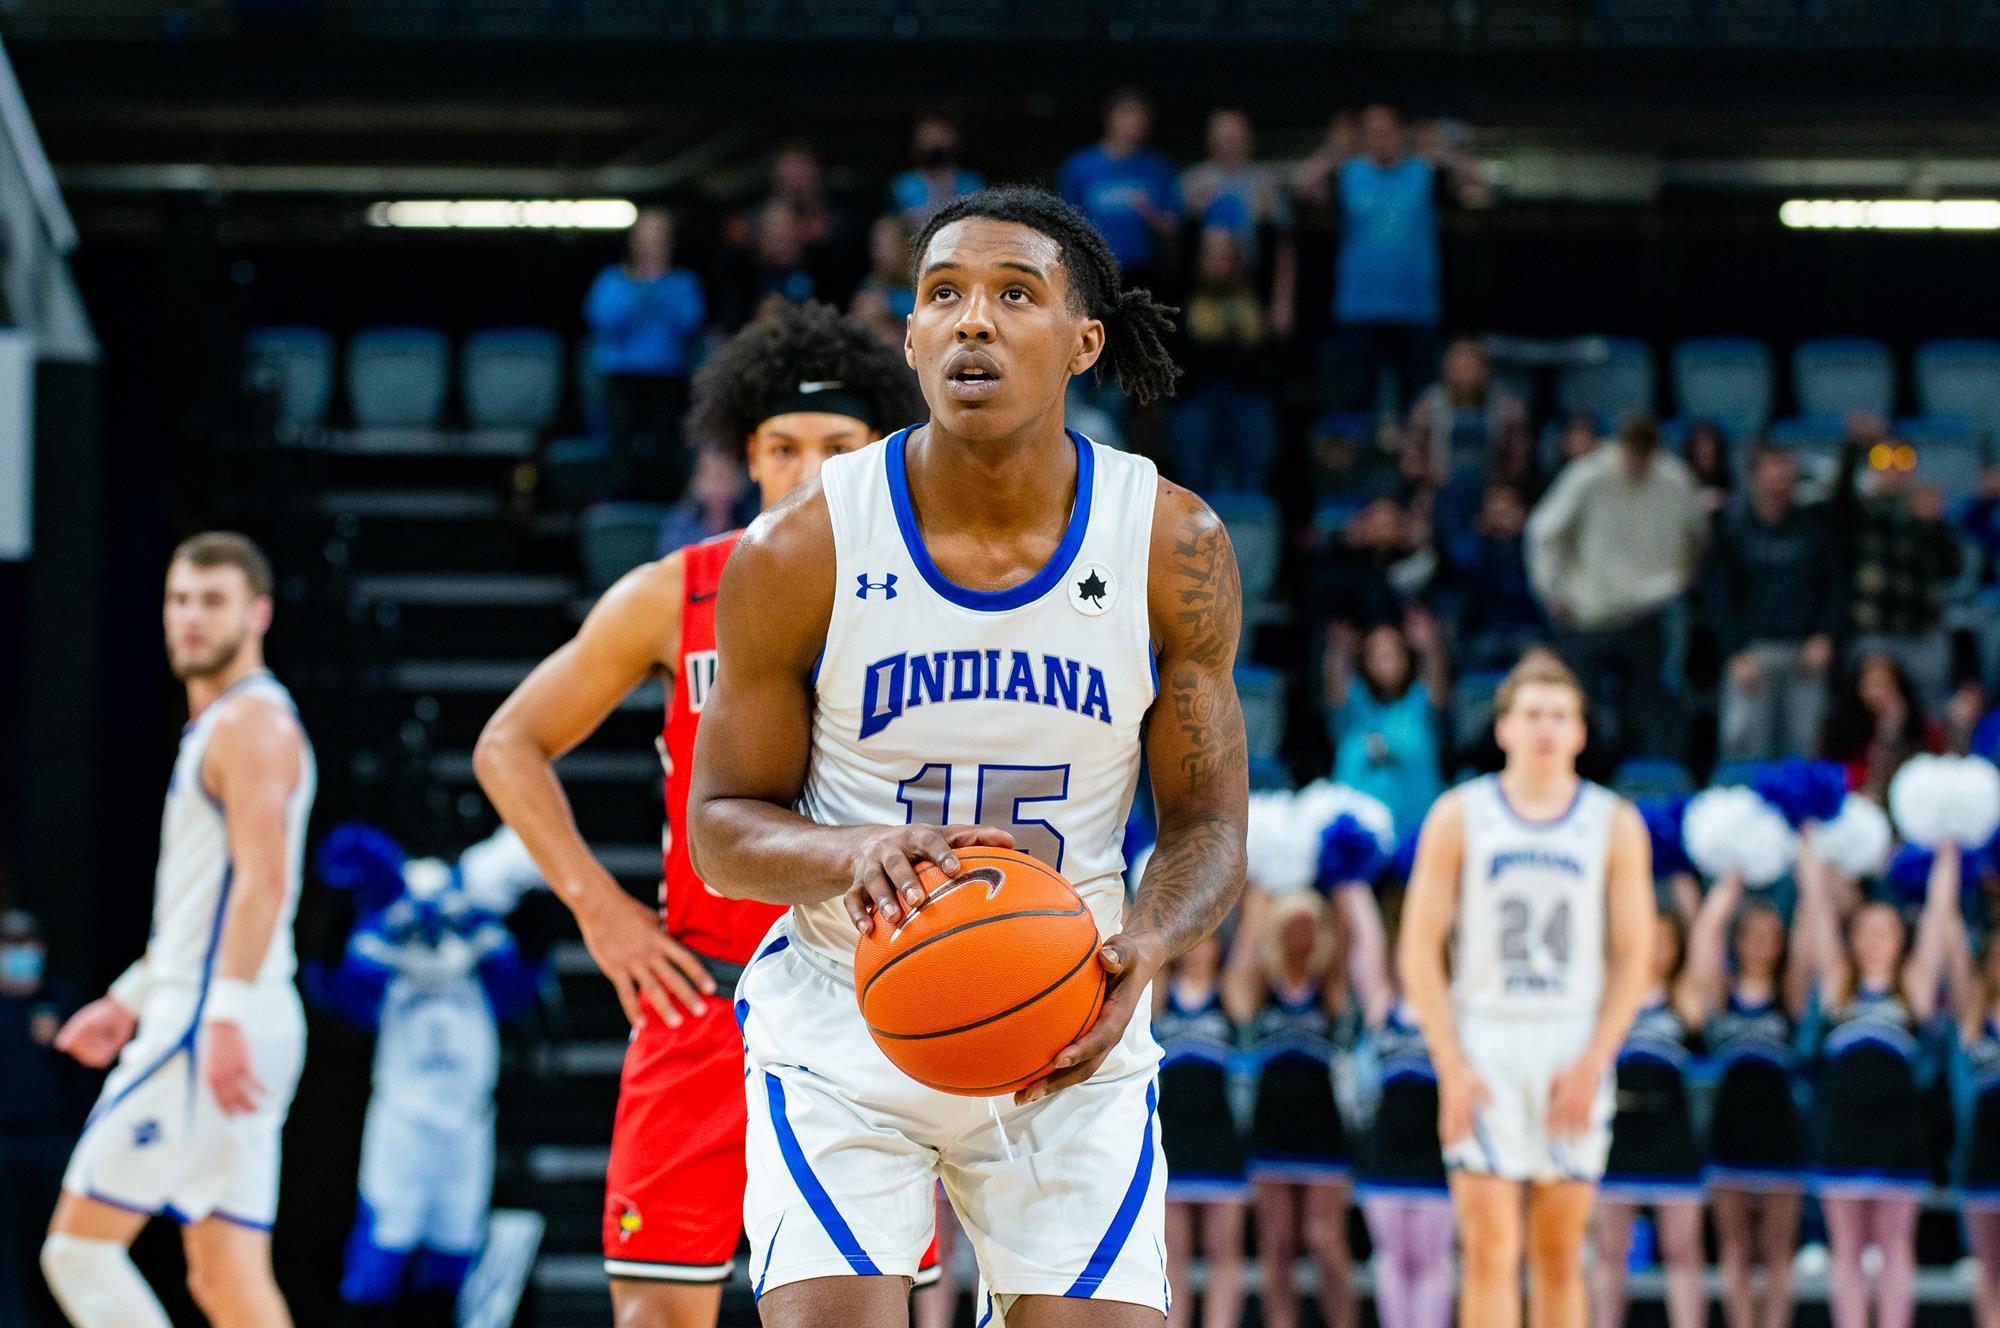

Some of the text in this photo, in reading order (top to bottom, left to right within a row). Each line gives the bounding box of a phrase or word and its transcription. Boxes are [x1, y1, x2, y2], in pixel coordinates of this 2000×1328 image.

[858, 649, 1112, 742] INDIANA
[896, 763, 1070, 873] 15
[1497, 896, 1571, 963] 24
